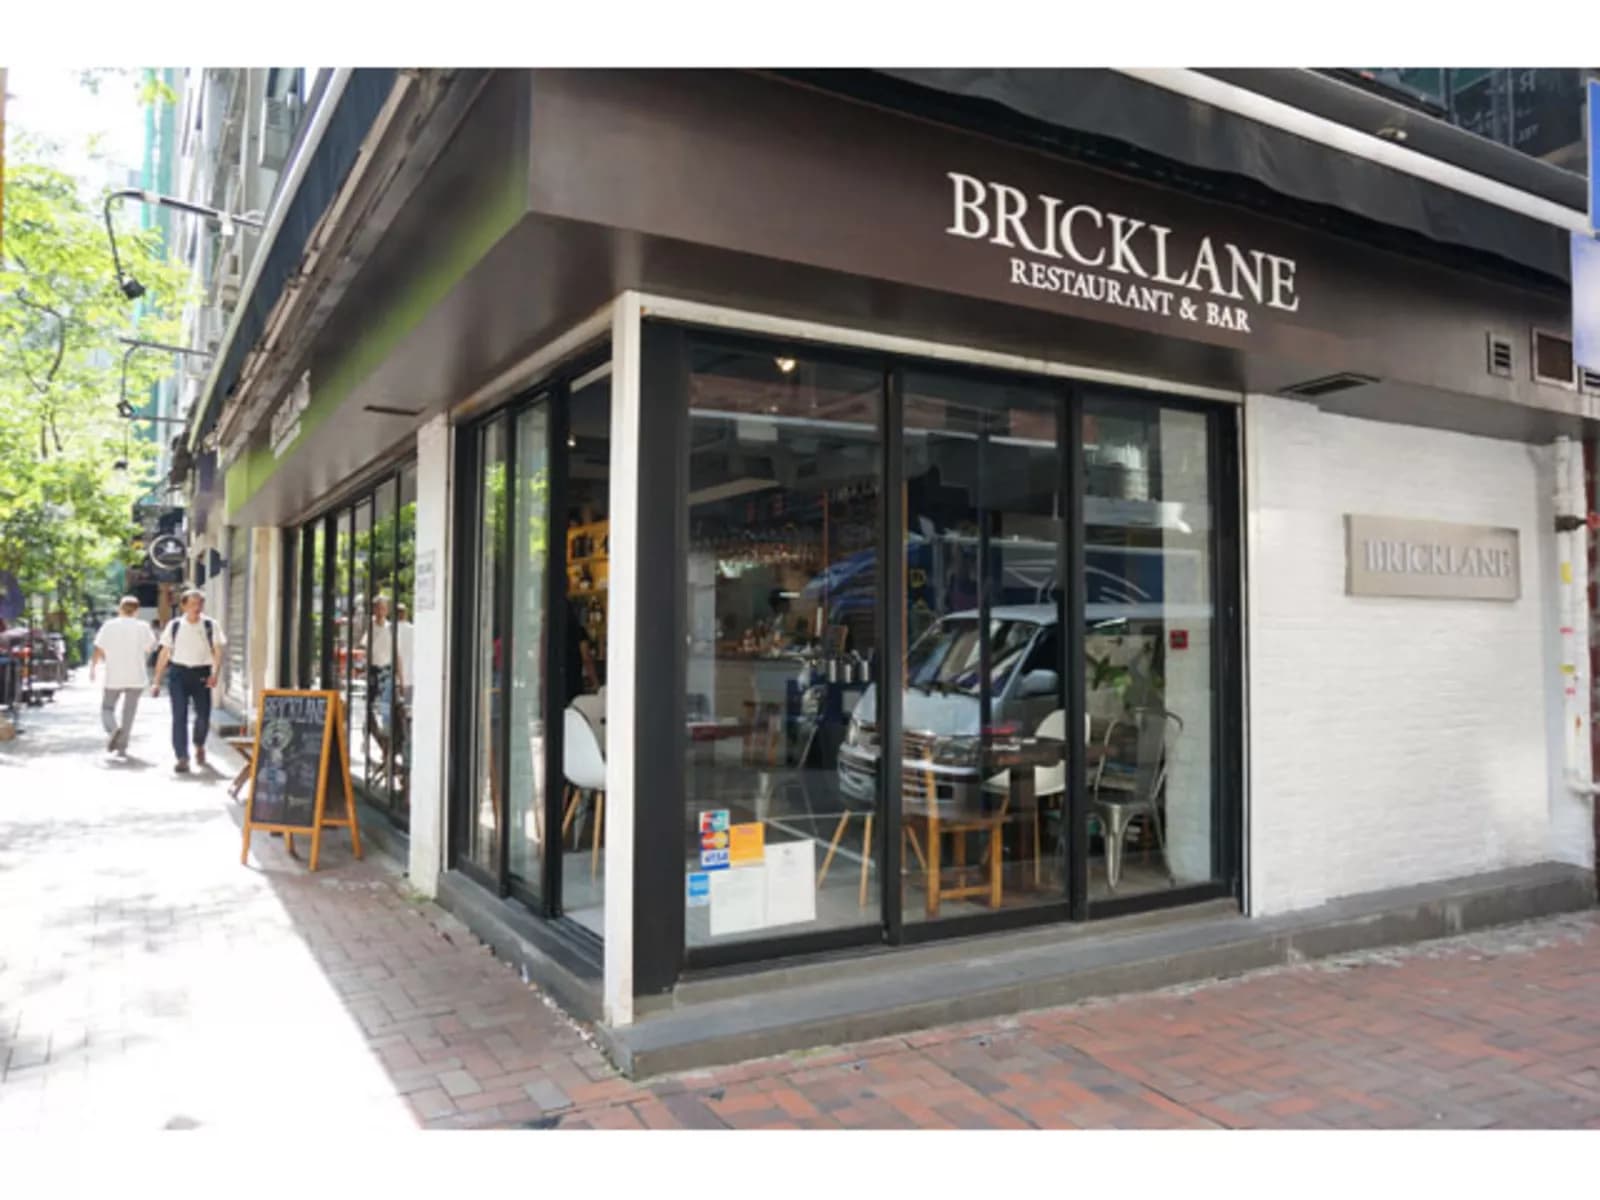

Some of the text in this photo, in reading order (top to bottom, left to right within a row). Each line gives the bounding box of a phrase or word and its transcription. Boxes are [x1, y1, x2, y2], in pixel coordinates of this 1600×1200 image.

[946, 172, 1300, 312] BRICKLANE
[1010, 257, 1252, 332] RESTAURANT & BAR
[1364, 540, 1514, 577] BRICKLANE
